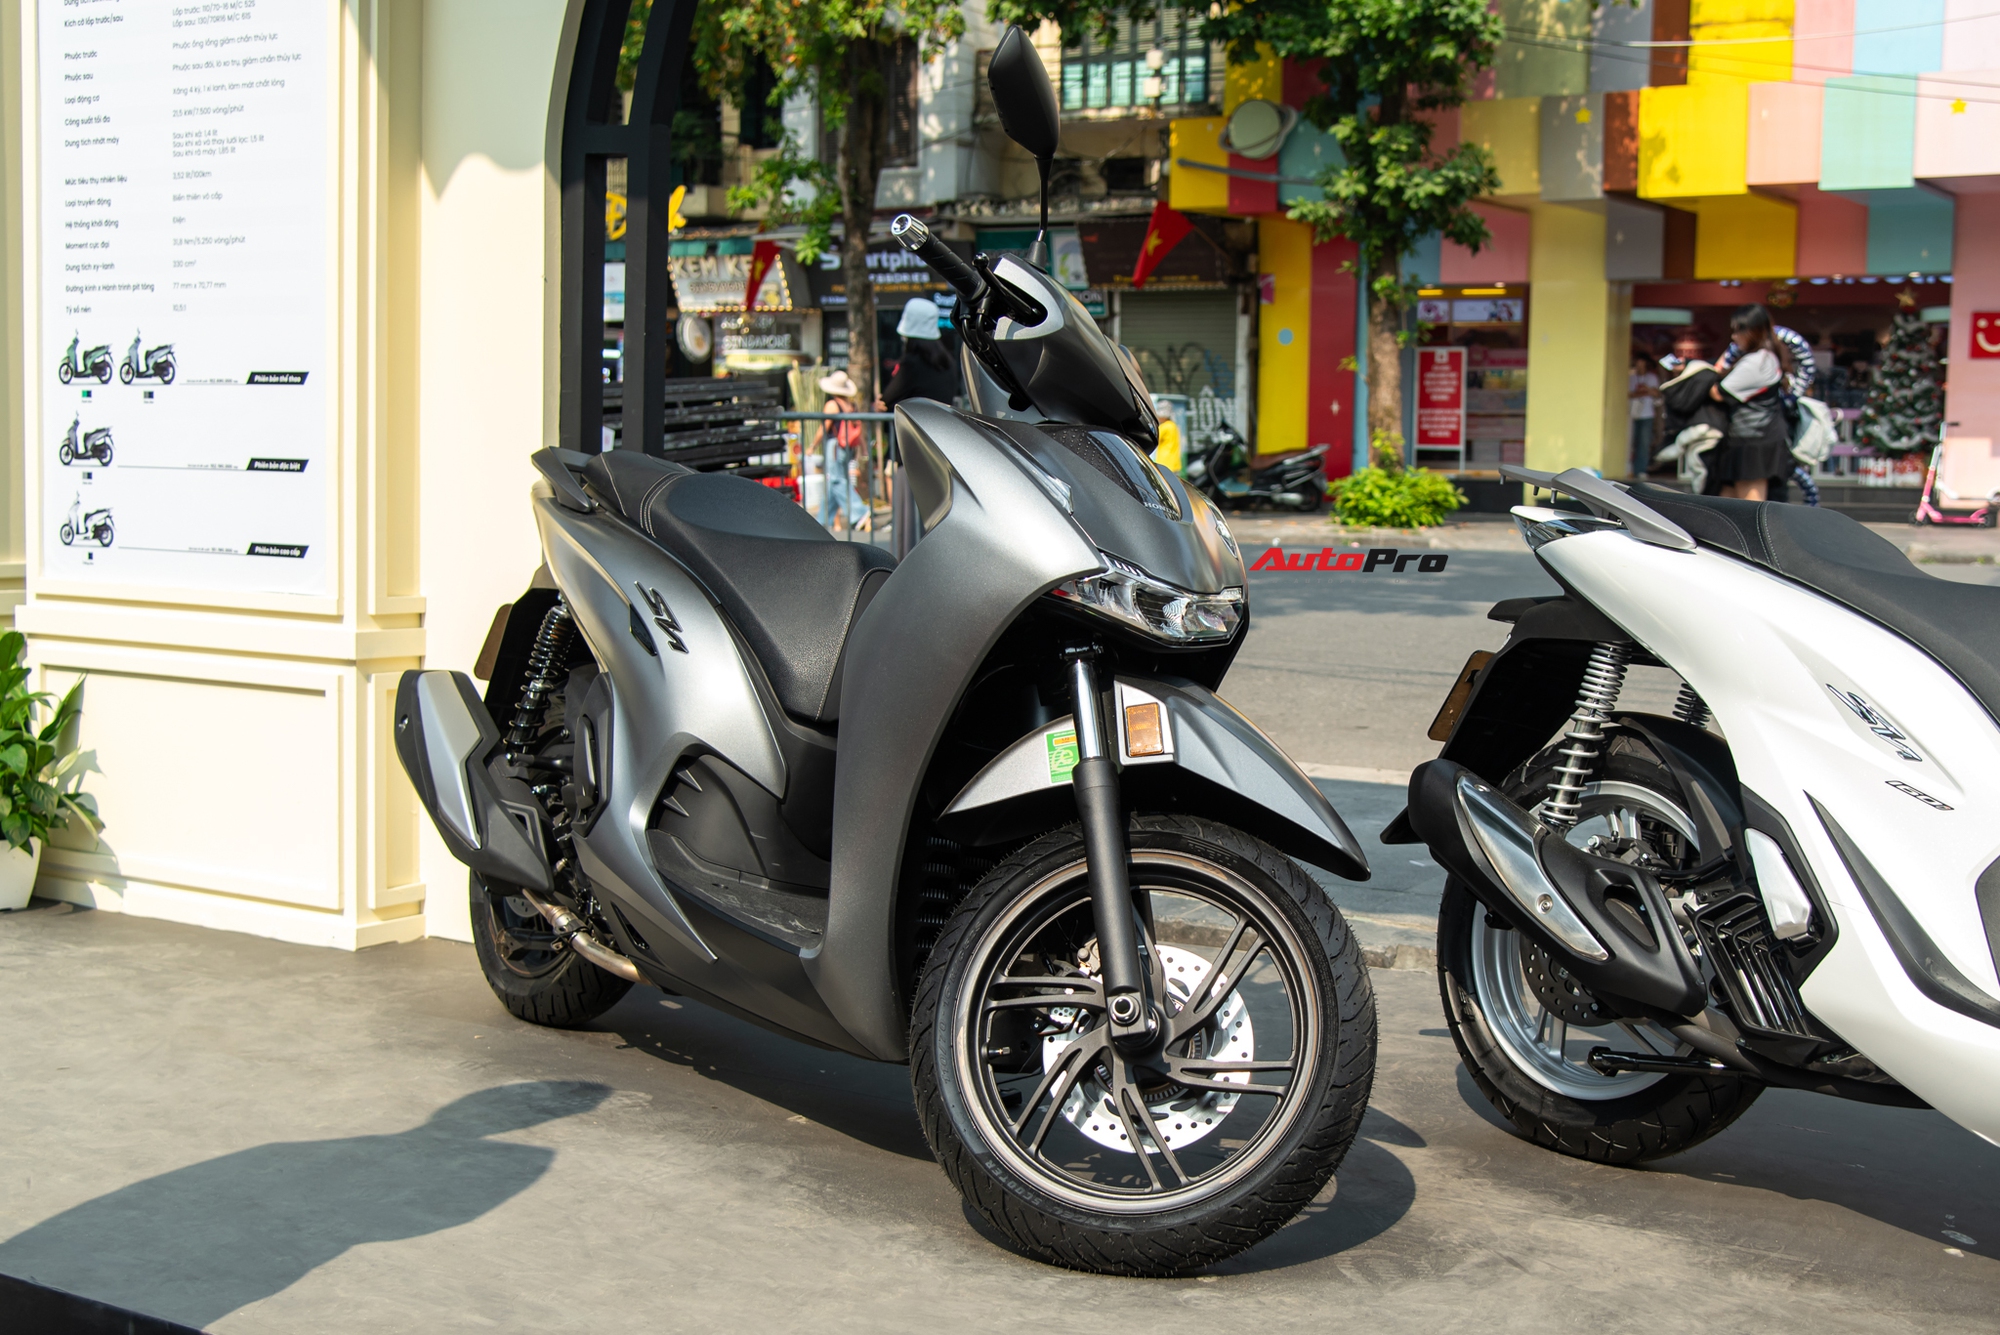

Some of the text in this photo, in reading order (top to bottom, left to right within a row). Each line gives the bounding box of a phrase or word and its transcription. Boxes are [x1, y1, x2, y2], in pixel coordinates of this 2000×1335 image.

[65, 139, 79, 149] Dung
[65, 264, 80, 273] Dung
[671, 255, 753, 278] KEM KE
[1143, 501, 1179, 517] HONDA
